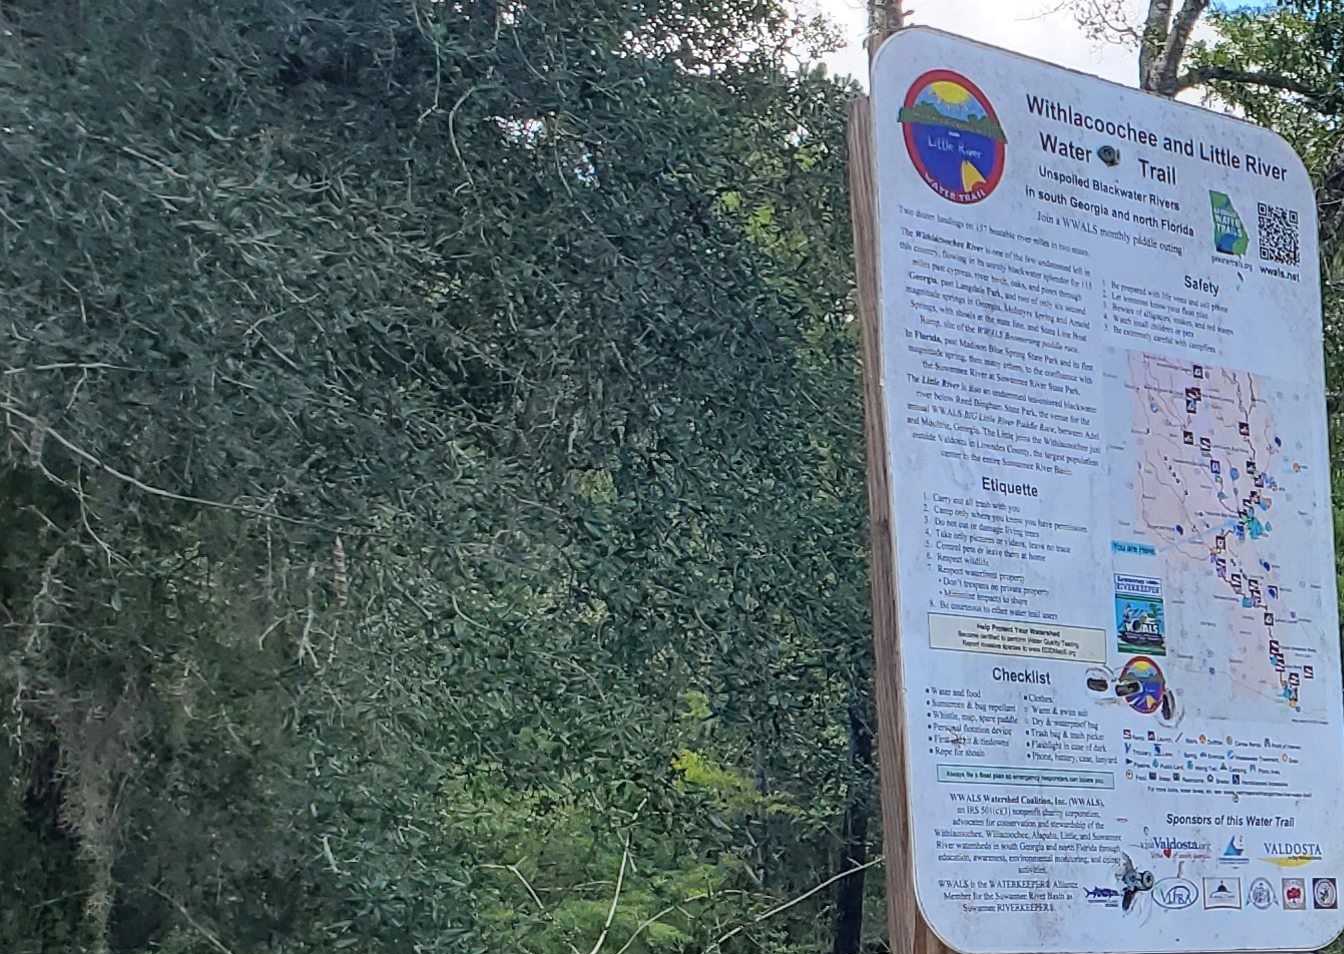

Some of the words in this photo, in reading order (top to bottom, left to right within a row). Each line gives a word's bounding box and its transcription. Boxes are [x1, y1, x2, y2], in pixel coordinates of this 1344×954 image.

[1026, 94, 1157, 147] Withlacoochee
[1164, 137, 1194, 157] and
[1199, 142, 1241, 169] Little
[1246, 154, 1287, 181] River
[1039, 132, 1092, 162] Water
[1138, 159, 1176, 185] Trail
[1039, 166, 1090, 188] Unspoiled
[1093, 180, 1147, 202] Blackwater
[1150, 193, 1180, 211] Rivers
[1025, 185, 1035, 197] in
[1038, 190, 1067, 205] south
[1070, 196, 1108, 216] Georgia
[1111, 207, 1130, 221] and
[1133, 211, 1159, 228] north
[1161, 219, 1194, 237] Florida
[1037, 211, 1054, 226] Join
[1062, 217, 1098, 235] WWALS
[1260, 265, 1300, 282] wwals.net
[1184, 275, 1219, 297] Safety
[982, 477, 1038, 497] Etiquette
[993, 667, 1051, 685] Checklist
[950, 793, 982, 803] WWALS
[983, 794, 1019, 805] Watershed
[1166, 813, 1213, 827] Sponsors
[1215, 814, 1225, 825] of
[1226, 815, 1244, 826] this
[1246, 816, 1273, 827] Water
[1274, 816, 1294, 828] Trail
[1264, 843, 1322, 855] VALDOSTA
